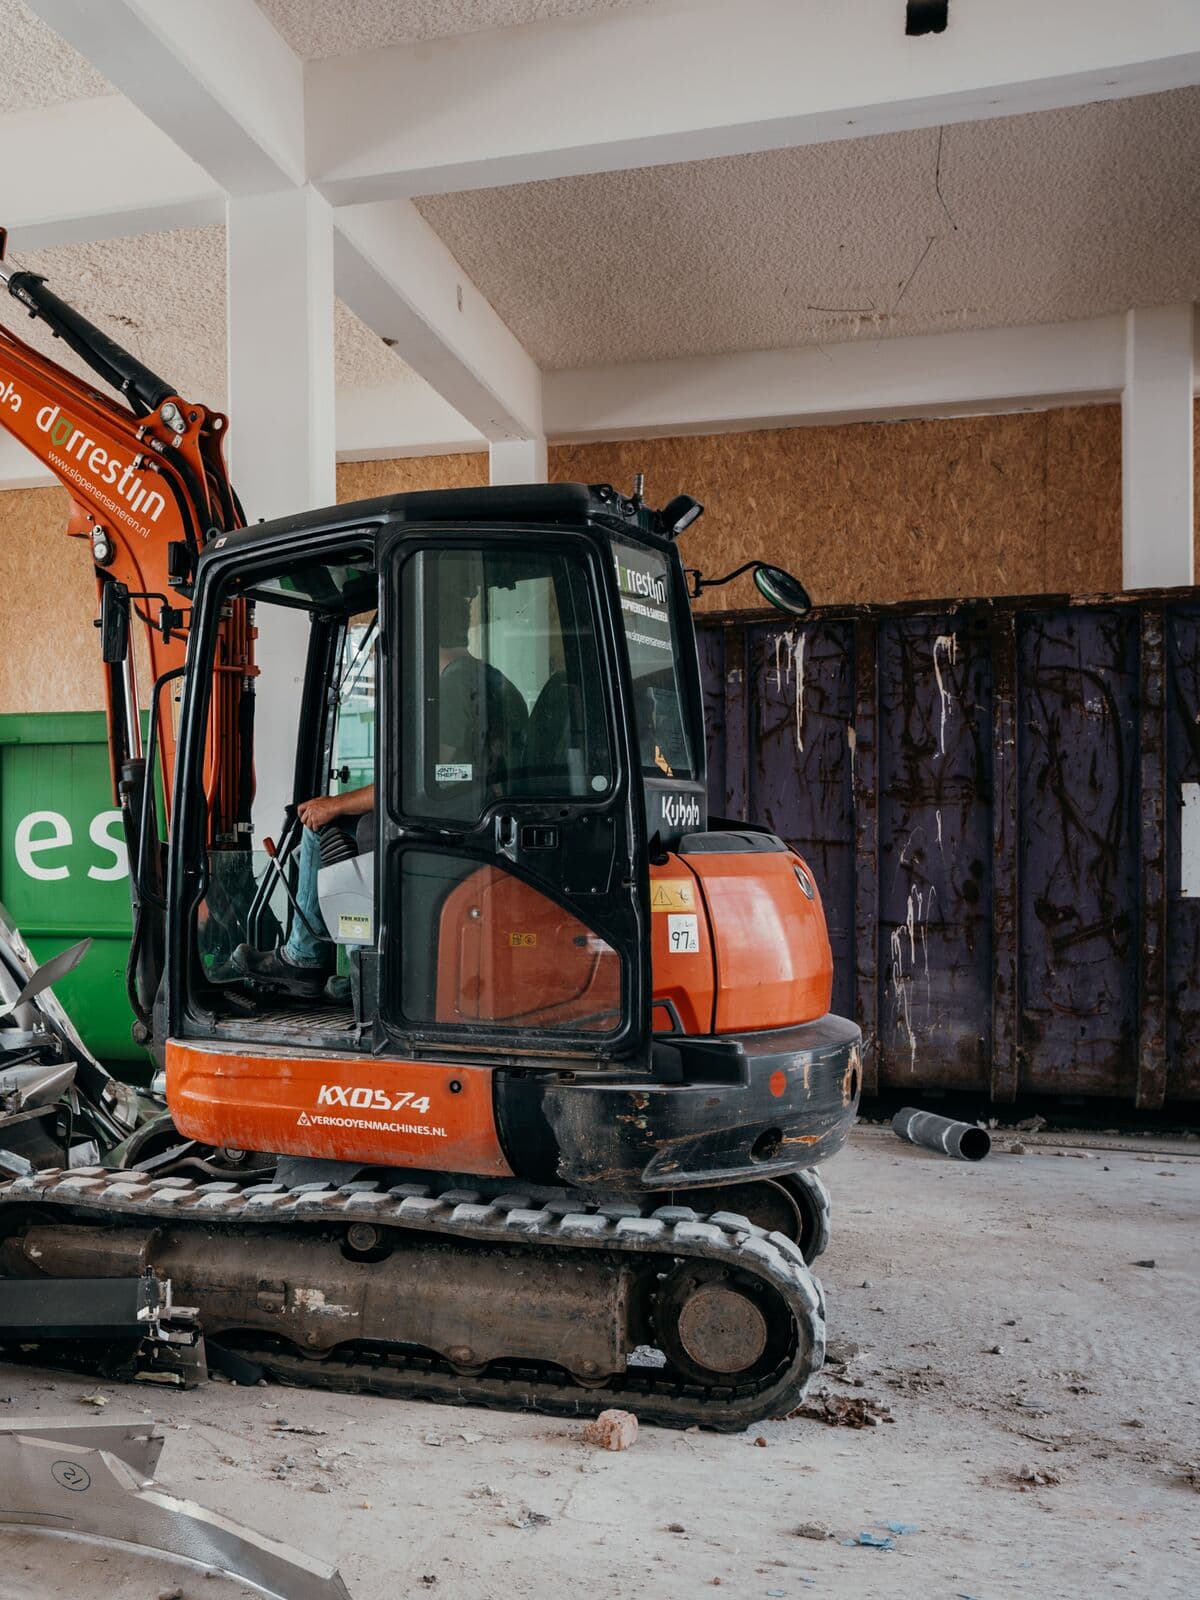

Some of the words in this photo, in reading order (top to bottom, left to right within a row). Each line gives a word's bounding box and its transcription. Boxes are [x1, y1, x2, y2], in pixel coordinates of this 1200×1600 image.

[48, 451, 151, 539] www.slopenensaneren.nl
[661, 796, 700, 826] Kubota
[671, 931, 689, 949] 97
[310, 1115, 448, 1137] VERKOOYENMACHINES.NL
